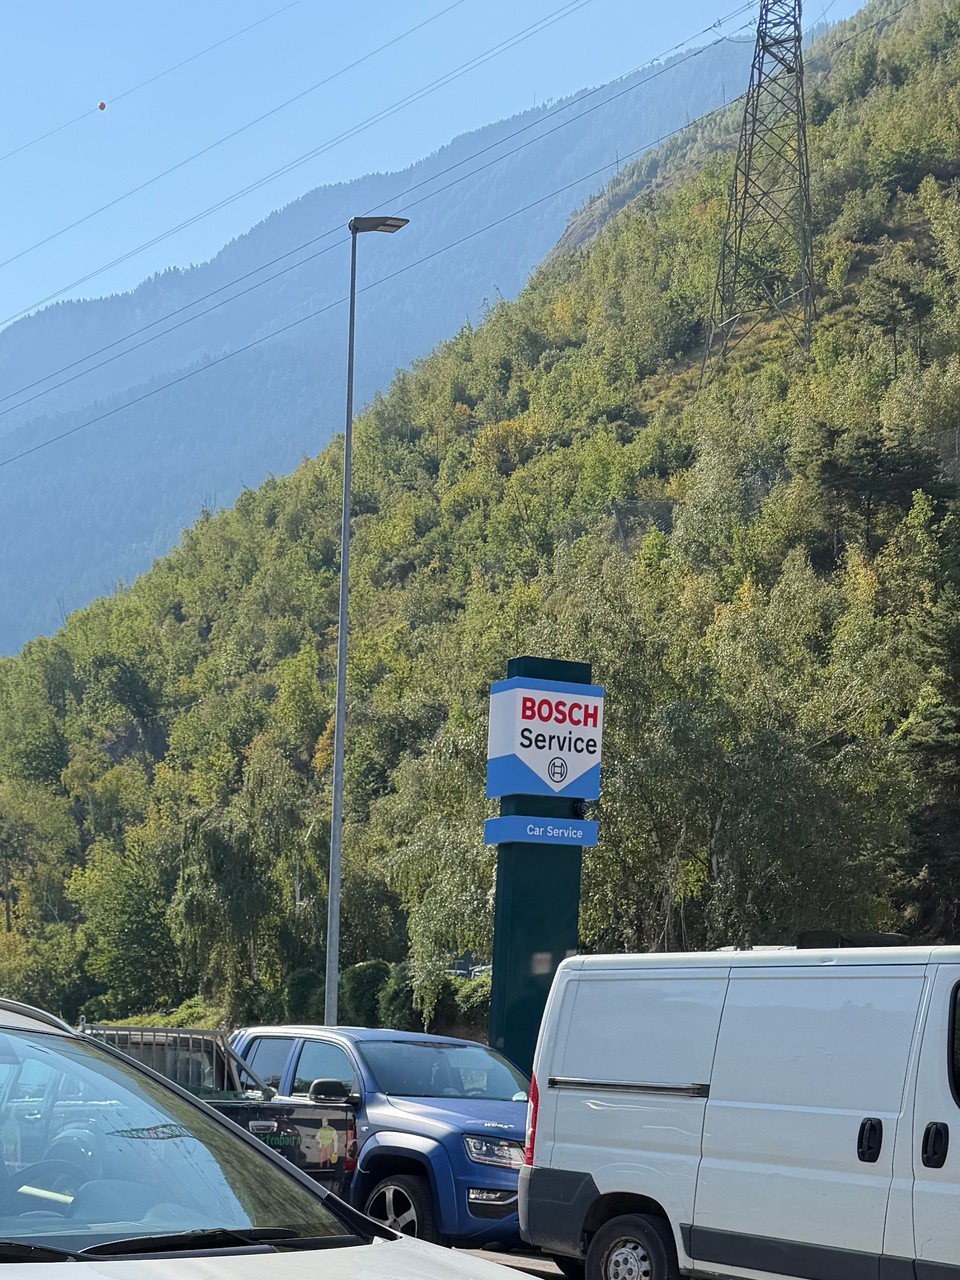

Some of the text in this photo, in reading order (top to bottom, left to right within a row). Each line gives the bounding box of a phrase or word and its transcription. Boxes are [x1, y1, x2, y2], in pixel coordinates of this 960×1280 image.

[521, 696, 599, 728] BOSCH
[519, 727, 598, 755] Service
[526, 824, 583, 839] Car Service
